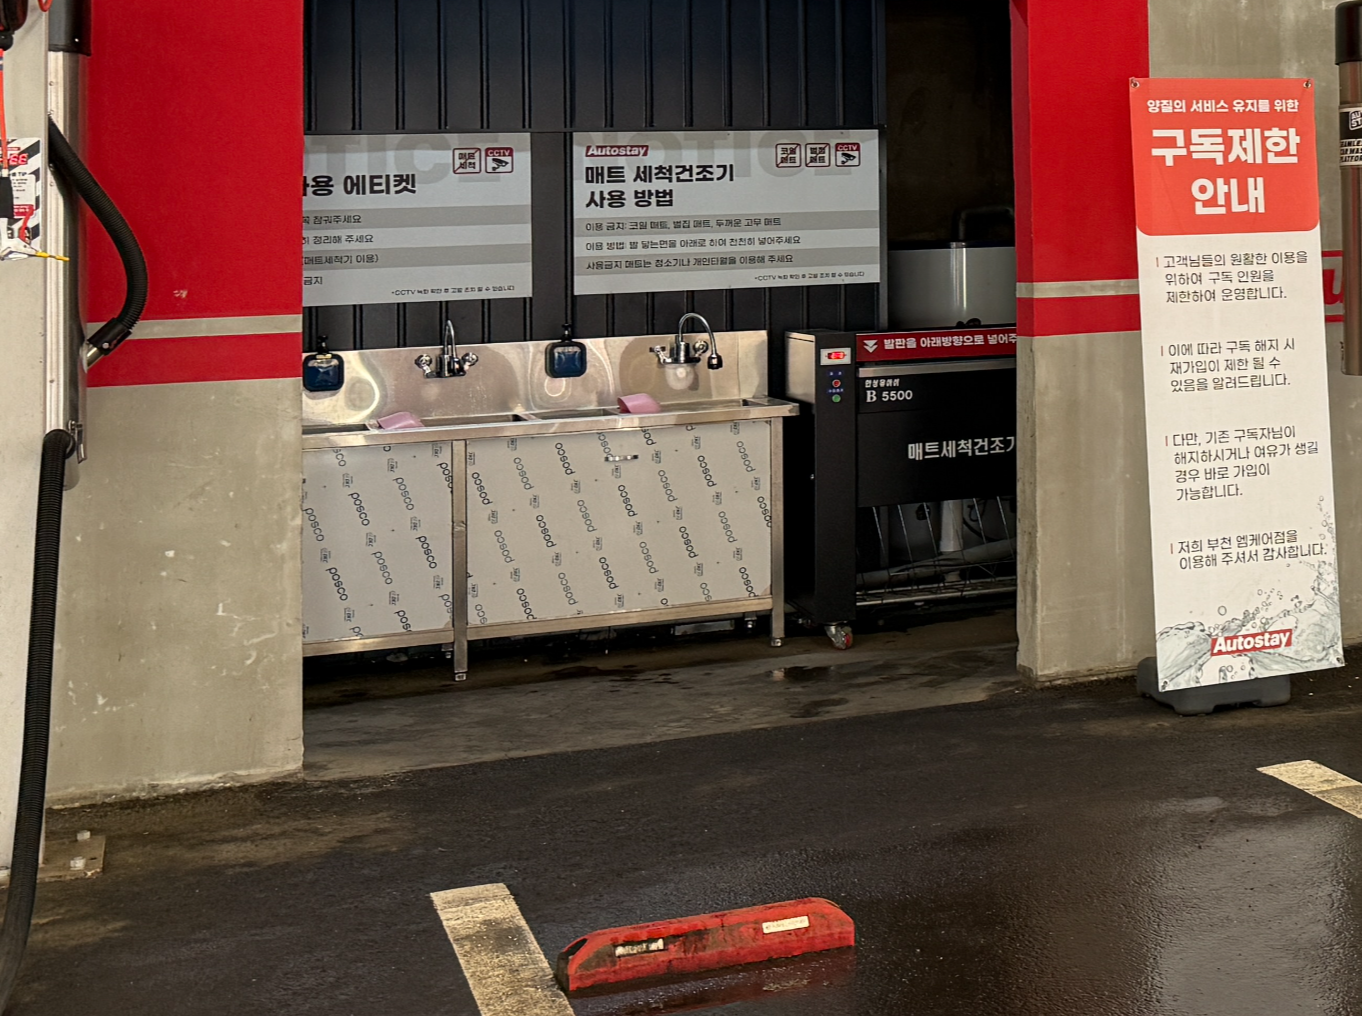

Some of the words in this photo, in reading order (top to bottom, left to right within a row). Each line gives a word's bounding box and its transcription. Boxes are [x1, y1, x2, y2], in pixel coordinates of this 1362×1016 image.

[1147, 99, 1186, 113] 양질의
[1190, 99, 1229, 113] 서비스
[1232, 99, 1270, 113] 유지를
[1274, 98, 1299, 113] 위한
[487, 149, 511, 157] CCTV
[587, 145, 649, 157] Autostay
[1151, 127, 1301, 167] 구독제한
[343, 173, 417, 195] 에티켓
[585, 165, 626, 184] 매트
[633, 163, 735, 184] 세척건조기
[585, 189, 626, 209] 사용
[633, 188, 674, 207] 방법
[1191, 176, 1266, 215] 안내
[585, 222, 603, 231] 이용
[716, 218, 742, 228] 두꺼운
[744, 217, 762, 227] 고무
[764, 217, 781, 226] 매트
[313, 235, 342, 245] 정리해
[345, 234, 374, 243] 주세요
[585, 241, 603, 251] 이용
[680, 238, 706, 248] 아래로
[729, 237, 756, 247] 천천히
[757, 235, 801, 246] 넣어주세요
[356, 254, 379, 264] 이용)
[767, 254, 793, 264] 주세요
[1163, 253, 1226, 268] 고객님들의
[1230, 251, 1268, 266] 원활한
[1271, 250, 1308, 265] 이용을
[303, 276, 323, 285] 금지
[1165, 272, 1202, 286] 위하여
[1208, 270, 1233, 284] 구독
[1237, 269, 1274, 283] 인원을
[1166, 289, 1216, 303] 제한하여
[1221, 286, 1288, 302] 운영합니다.
[883, 337, 917, 350] 발판을
[920, 334, 985, 348] 아래방향으로
[1168, 342, 1193, 357] 이에
[1197, 341, 1222, 355] 따라
[1226, 339, 1250, 354] 구독
[1254, 338, 1279, 352] 해지
[1283, 337, 1295, 351] 시
[1170, 359, 1220, 375] 재가입이
[1224, 357, 1249, 372] 제한
[1268, 356, 1281, 369] 수
[1170, 377, 1209, 393] 있음을
[1212, 372, 1291, 391] 알려드립니다.
[866, 390, 877, 403] B
[881, 389, 913, 402] 5500
[1172, 433, 1202, 447] 다만,
[1205, 430, 1230, 445] 기존
[1233, 425, 1296, 442] 구독자님이
[555, 442, 575, 475] posco
[736, 440, 756, 473] posco
[1174, 446, 1250, 465] 해지하시거나
[1254, 443, 1291, 459] 여유가
[1294, 441, 1319, 456] 생길
[513, 457, 534, 490] posco
[697, 455, 717, 488] posco
[1175, 468, 1200, 483] 경우
[1204, 466, 1230, 481] 바로
[1233, 462, 1271, 478] 가입이
[392, 477, 414, 511] posco
[472, 471, 493, 505] posco
[657, 469, 678, 502] posco
[1176, 483, 1243, 501] 가능합니다.
[348, 492, 370, 526] posco
[618, 484, 638, 517] posco
[302, 507, 325, 542] posco
[577, 499, 597, 533] posco
[718, 511, 737, 543] posco
[536, 515, 557, 548] posco
[678, 526, 698, 558] posco
[1178, 539, 1203, 554] 저희
[1207, 536, 1232, 551] 부천
[1236, 529, 1298, 547] 엠케어점을
[415, 535, 437, 569] posco
[494, 529, 515, 564] posco
[639, 541, 659, 574] posco
[1179, 554, 1217, 570] 이용해
[1221, 549, 1259, 565] 주셔서
[1262, 542, 1328, 562] 감사합니다.
[371, 551, 393, 585] posco
[599, 556, 619, 589] posco
[325, 566, 348, 601] posco
[558, 572, 578, 605] posco
[739, 566, 759, 597] posco
[516, 588, 537, 620] posco
[1213, 631, 1291, 654] Autostay
